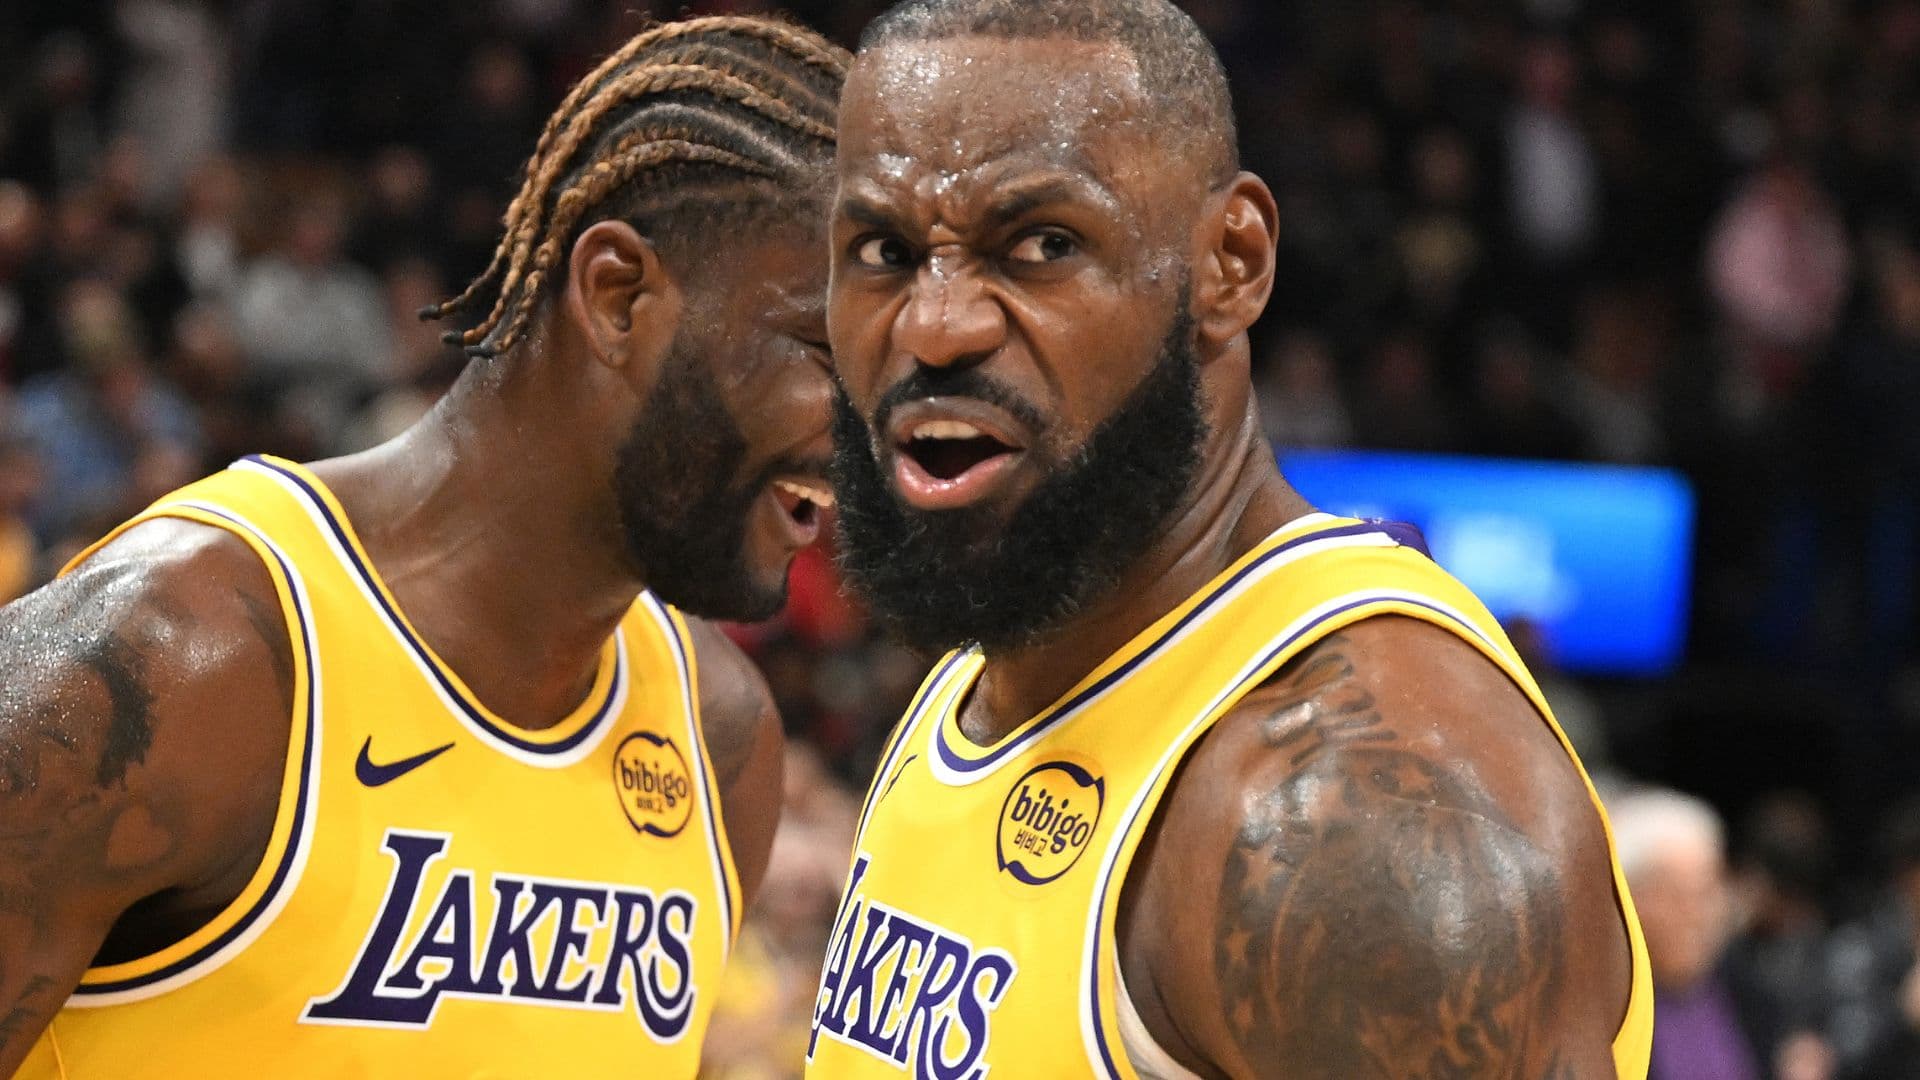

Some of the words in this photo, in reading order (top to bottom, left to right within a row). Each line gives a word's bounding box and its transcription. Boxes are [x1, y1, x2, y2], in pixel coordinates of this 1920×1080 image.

[620, 758, 688, 808] bibigo
[1010, 785, 1090, 854] bibigo
[1013, 828, 1048, 858] 비비고
[300, 830, 697, 1041] LAKERS
